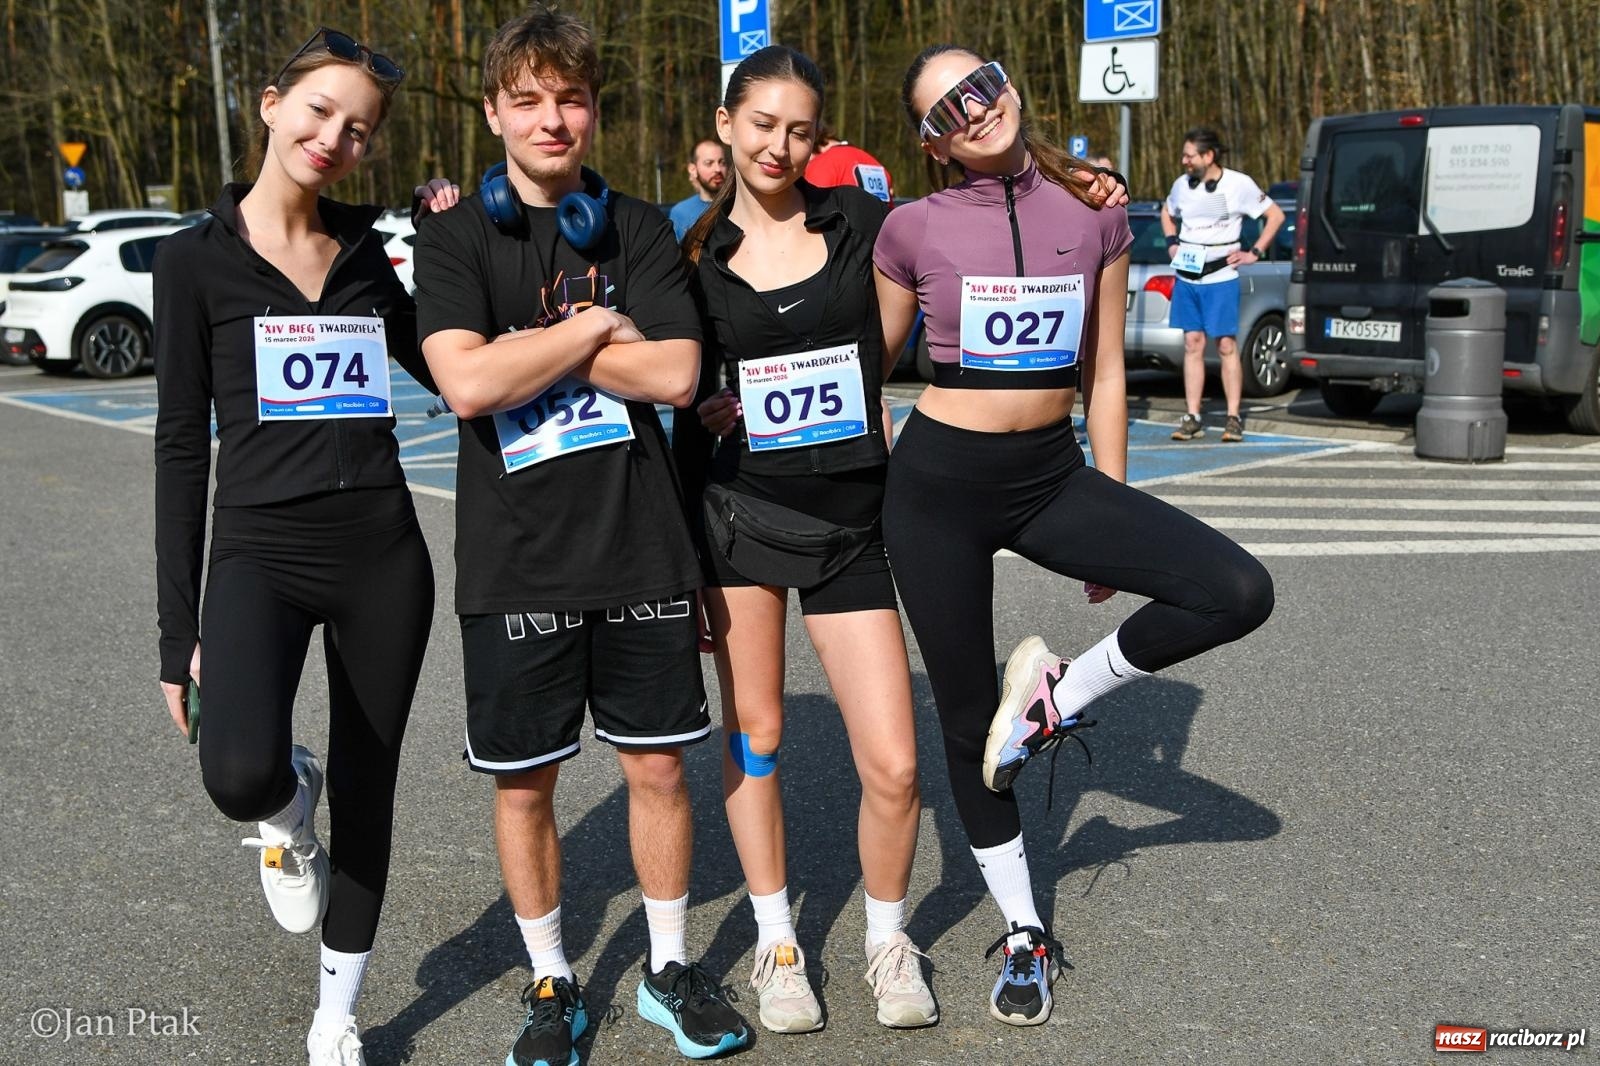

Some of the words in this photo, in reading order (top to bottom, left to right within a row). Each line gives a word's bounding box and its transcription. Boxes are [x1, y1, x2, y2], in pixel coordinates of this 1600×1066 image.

[731, 0, 758, 33] P
[868, 177, 884, 191] 018
[1182, 252, 1196, 263] 114
[1312, 262, 1357, 272] RENAULT
[1496, 264, 1534, 277] Trafic
[971, 284, 989, 293] XIV
[992, 284, 1017, 294] BIEG
[1022, 283, 1077, 294] TWARDZIELA
[264, 323, 284, 334] XIV
[288, 323, 315, 334] BIEG
[319, 323, 377, 334] TWARDZIELA
[985, 310, 1065, 346] 027
[1335, 321, 1350, 336] TK
[282, 352, 370, 391] 074
[746, 367, 761, 377] XIV
[764, 363, 787, 375] BIEG
[790, 353, 851, 371] TWARDZIELA
[753, 376, 773, 384] marzec
[517, 385, 603, 435] 052
[764, 381, 843, 425] 075
